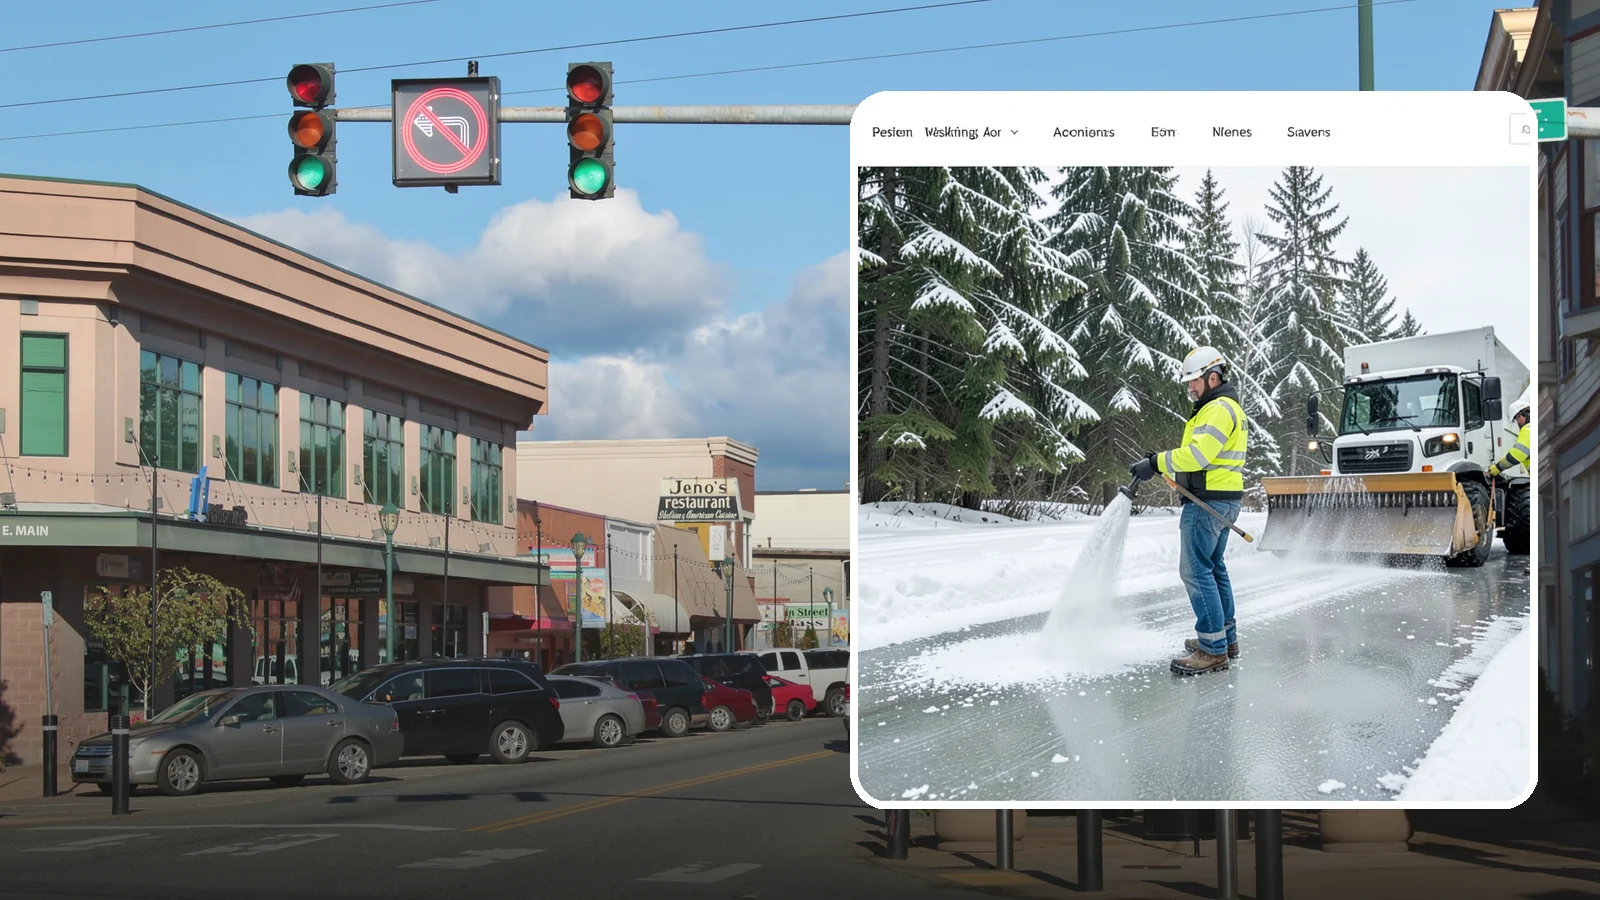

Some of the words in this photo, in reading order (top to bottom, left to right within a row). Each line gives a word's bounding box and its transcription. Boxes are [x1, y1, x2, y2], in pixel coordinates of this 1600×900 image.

[670, 480, 727, 494] Jeno's
[665, 496, 731, 509] restaurant
[686, 510, 714, 519] American
[715, 509, 737, 519] Cuisine
[2, 525, 13, 536] E.
[15, 525, 49, 536] MAIN
[797, 607, 829, 617] Street
